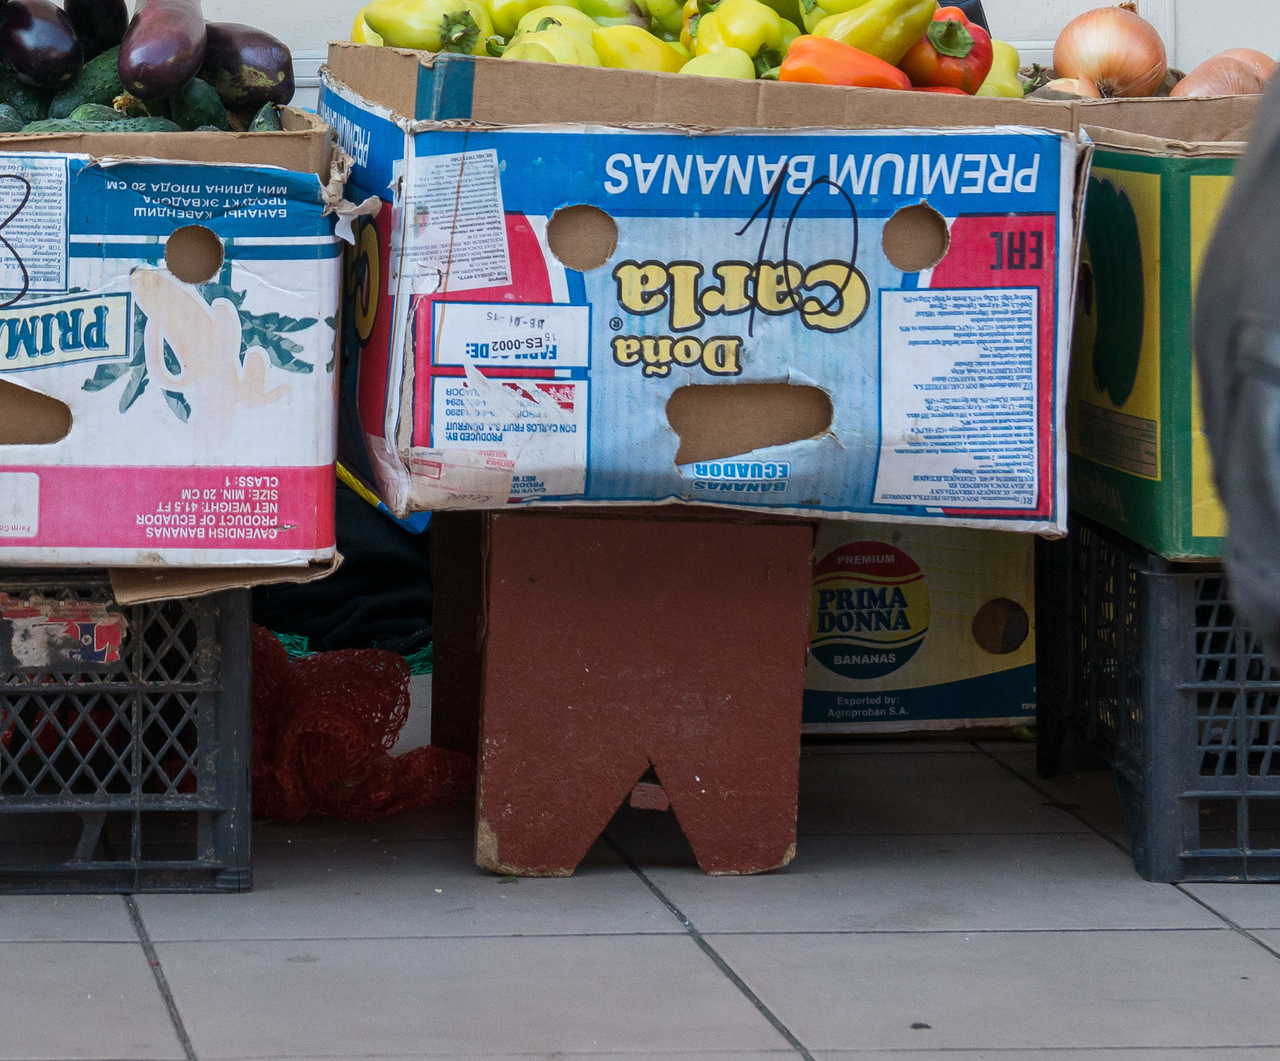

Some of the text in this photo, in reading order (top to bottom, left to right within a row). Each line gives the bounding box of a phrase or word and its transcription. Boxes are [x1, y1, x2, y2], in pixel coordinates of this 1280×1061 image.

[604, 153, 1040, 195] PREMIUM BANANAS
[106, 180, 287, 194] МИН ДЛИНА ПЛОДА 20 СМ
[223, 197, 286, 207] ПРОДУКТ
[133, 207, 287, 219] БАНАНЫ КАВЕНДИШ
[610, 261, 870, 334] Carla
[492, 337, 543, 351] ES-0002
[610, 336, 742, 377] Doña
[502, 423, 524, 431] FRUIT
[526, 423, 558, 432] CARLOS
[560, 424, 577, 432] DON
[445, 432, 503, 441] PRODUCED BY:
[694, 463, 788, 478] ECUADOR
[224, 477, 278, 487] CLASS: 1
[692, 481, 786, 492] BANANAS
[182, 489, 278, 500] SIZE: MIN. 20 CM
[157, 502, 278, 513] NET WEIGHT: 41.5 FT
[136, 514, 278, 525] PRODUCT OF ECUADOR
[146, 527, 277, 539] CAVENDISH BANANAS
[838, 555, 895, 564] PREMIUM
[818, 586, 908, 610] PRIMA
[817, 609, 911, 633] DONNA
[833, 654, 896, 665] BANANAS
[837, 696, 900, 707] Exported by:
[828, 707, 909, 718] Agroproban S.A.
